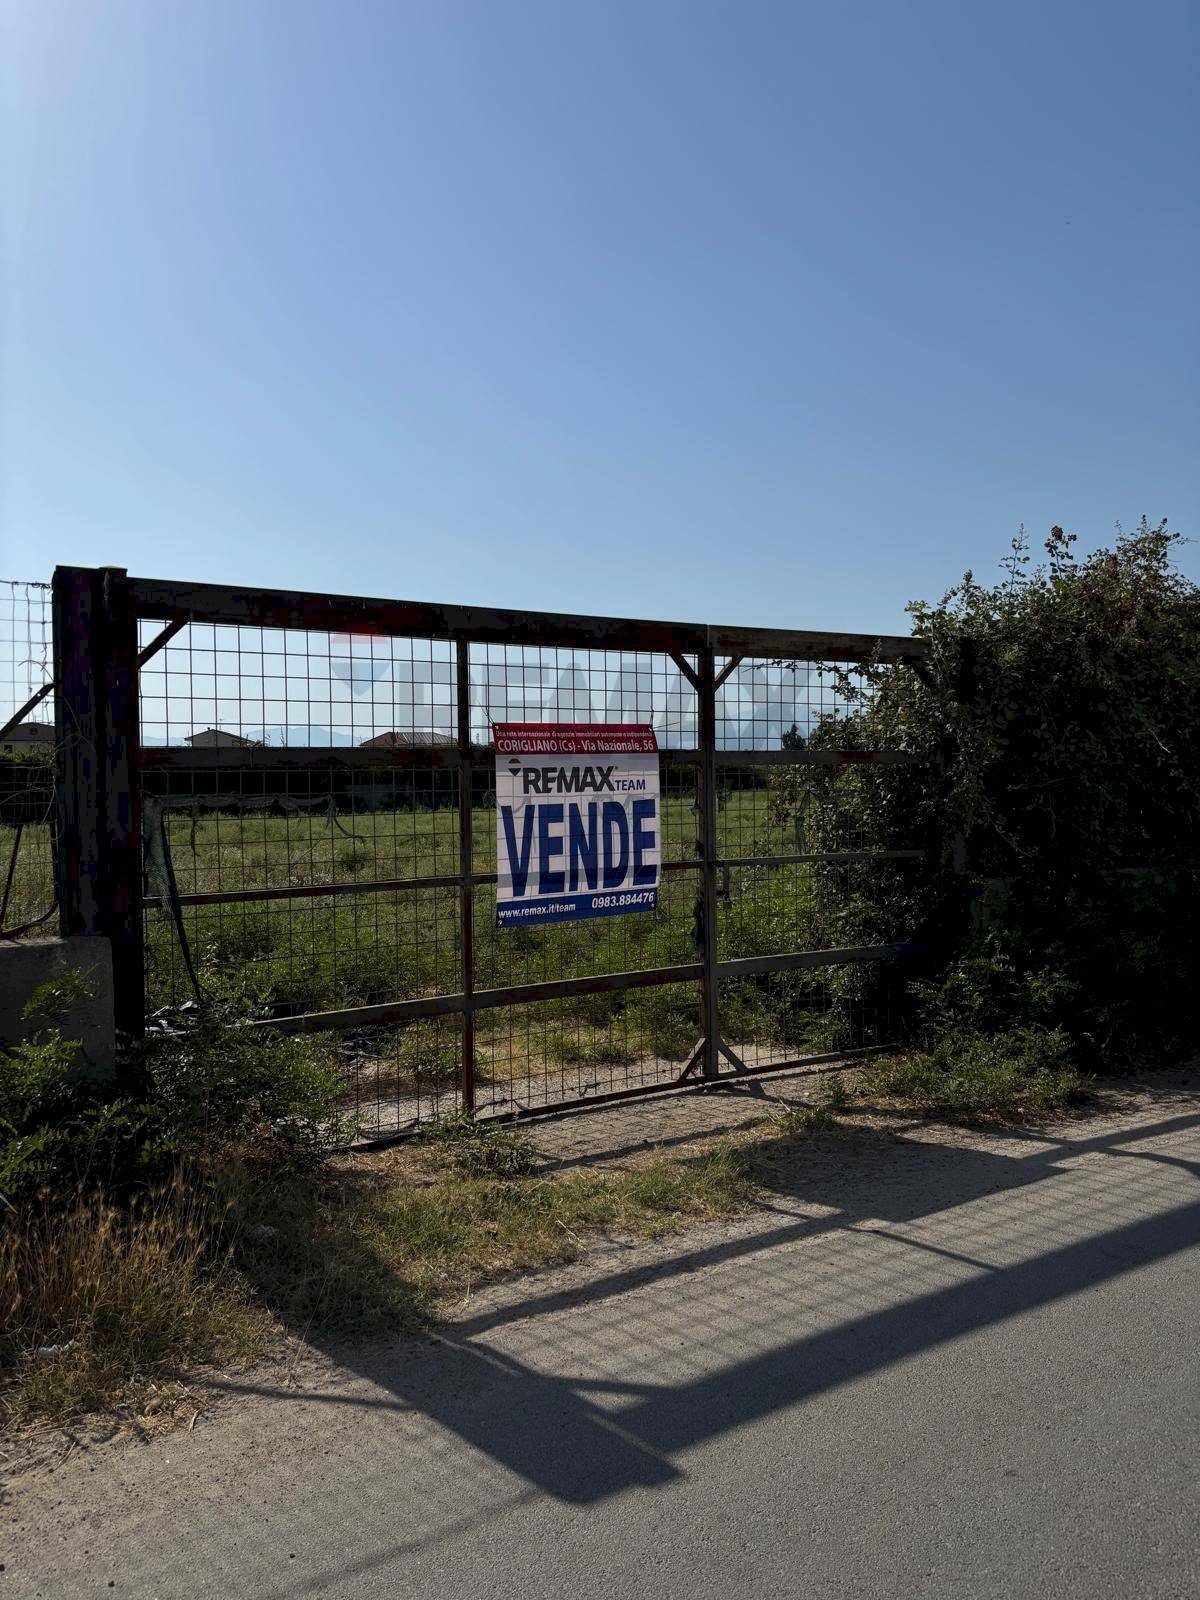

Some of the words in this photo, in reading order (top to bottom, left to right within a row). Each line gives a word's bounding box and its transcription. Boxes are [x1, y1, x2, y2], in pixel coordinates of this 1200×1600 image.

[498, 740, 557, 752] CORIGLIANO
[559, 740, 576, 752] (Cs)
[581, 740, 596, 751] Via
[597, 740, 642, 752] Nazionale,
[643, 740, 654, 751] 56
[615, 779, 646, 791] TEAM
[500, 799, 657, 896] VENDE
[591, 892, 655, 909] 0983.884476
[498, 903, 576, 918] www.remax.it/team
